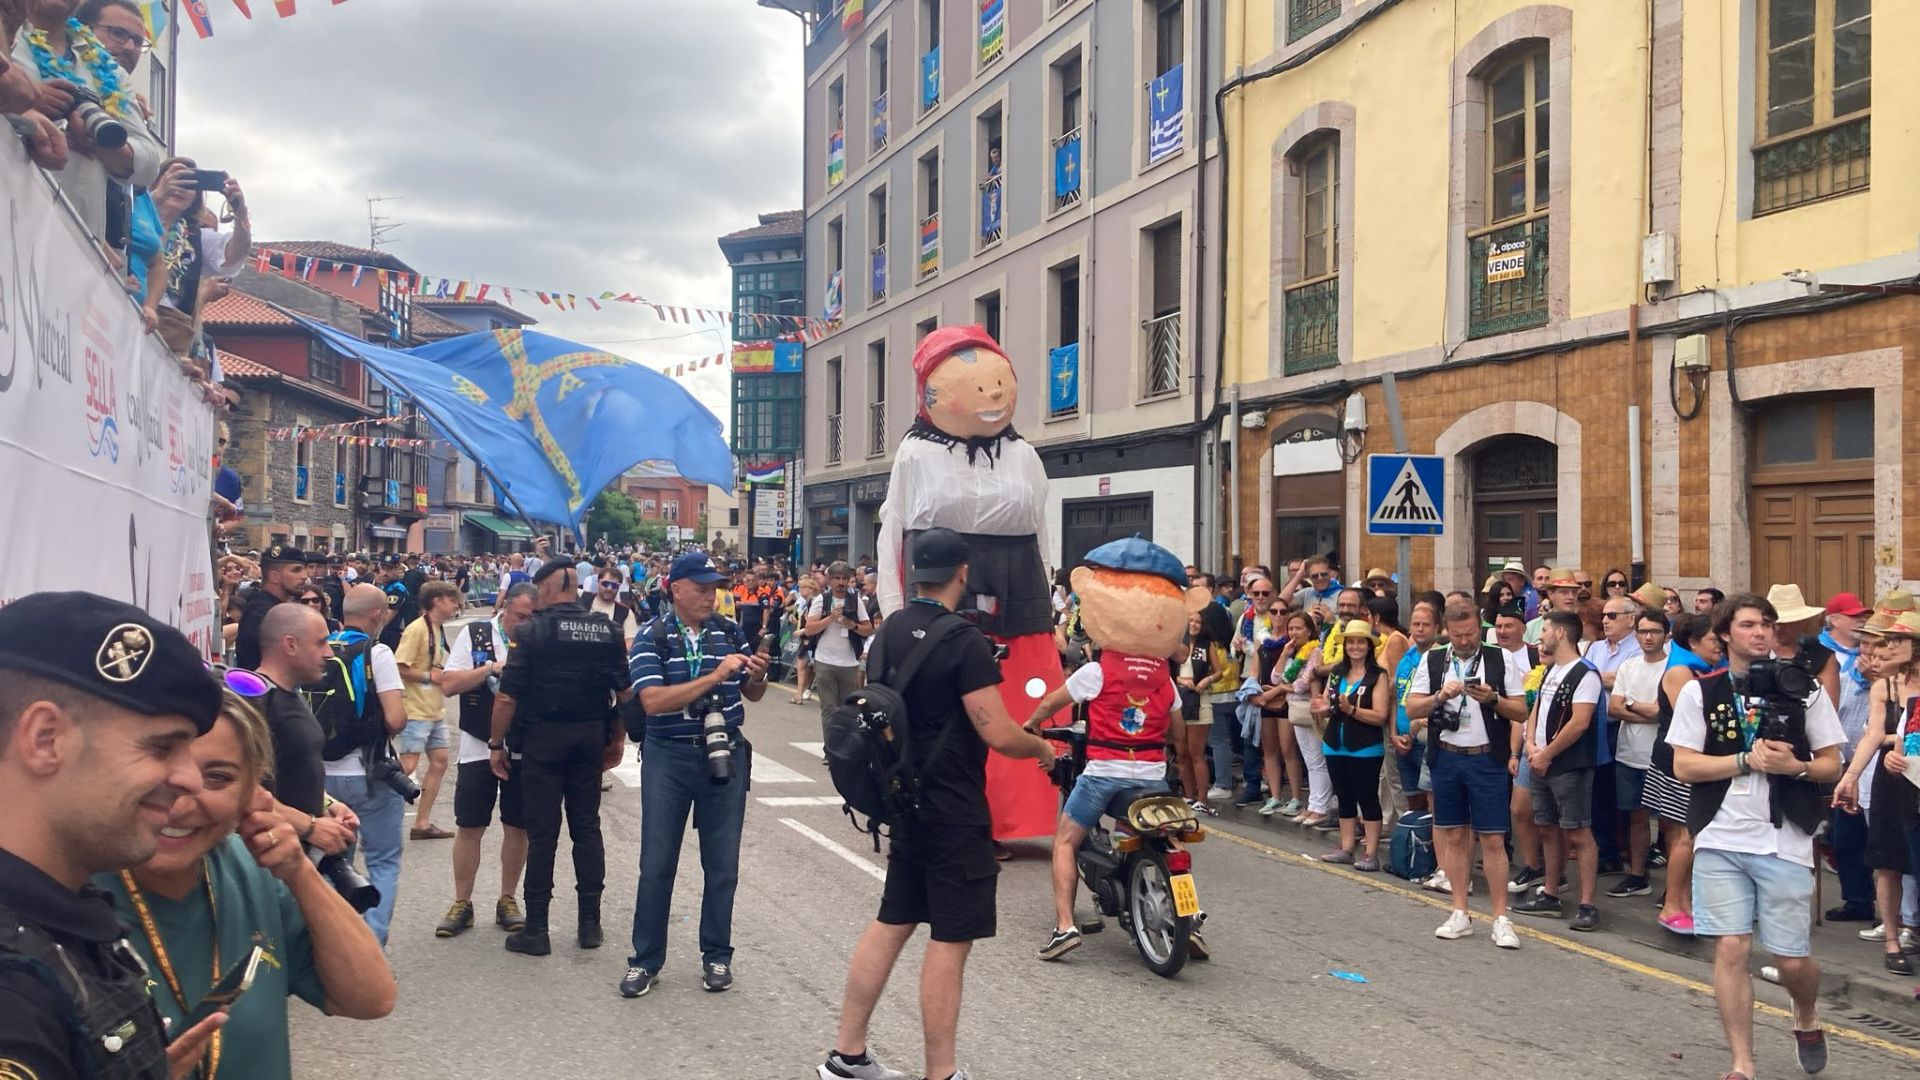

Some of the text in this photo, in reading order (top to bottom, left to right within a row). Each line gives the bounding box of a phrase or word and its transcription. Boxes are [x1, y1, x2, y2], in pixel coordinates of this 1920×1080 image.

[1501, 241, 1525, 252] alpaca
[1488, 256, 1524, 273] VENDE
[85, 346, 117, 416] SELLA
[560, 621, 611, 634] GUARDIA
[571, 631, 601, 641] CIVIL
